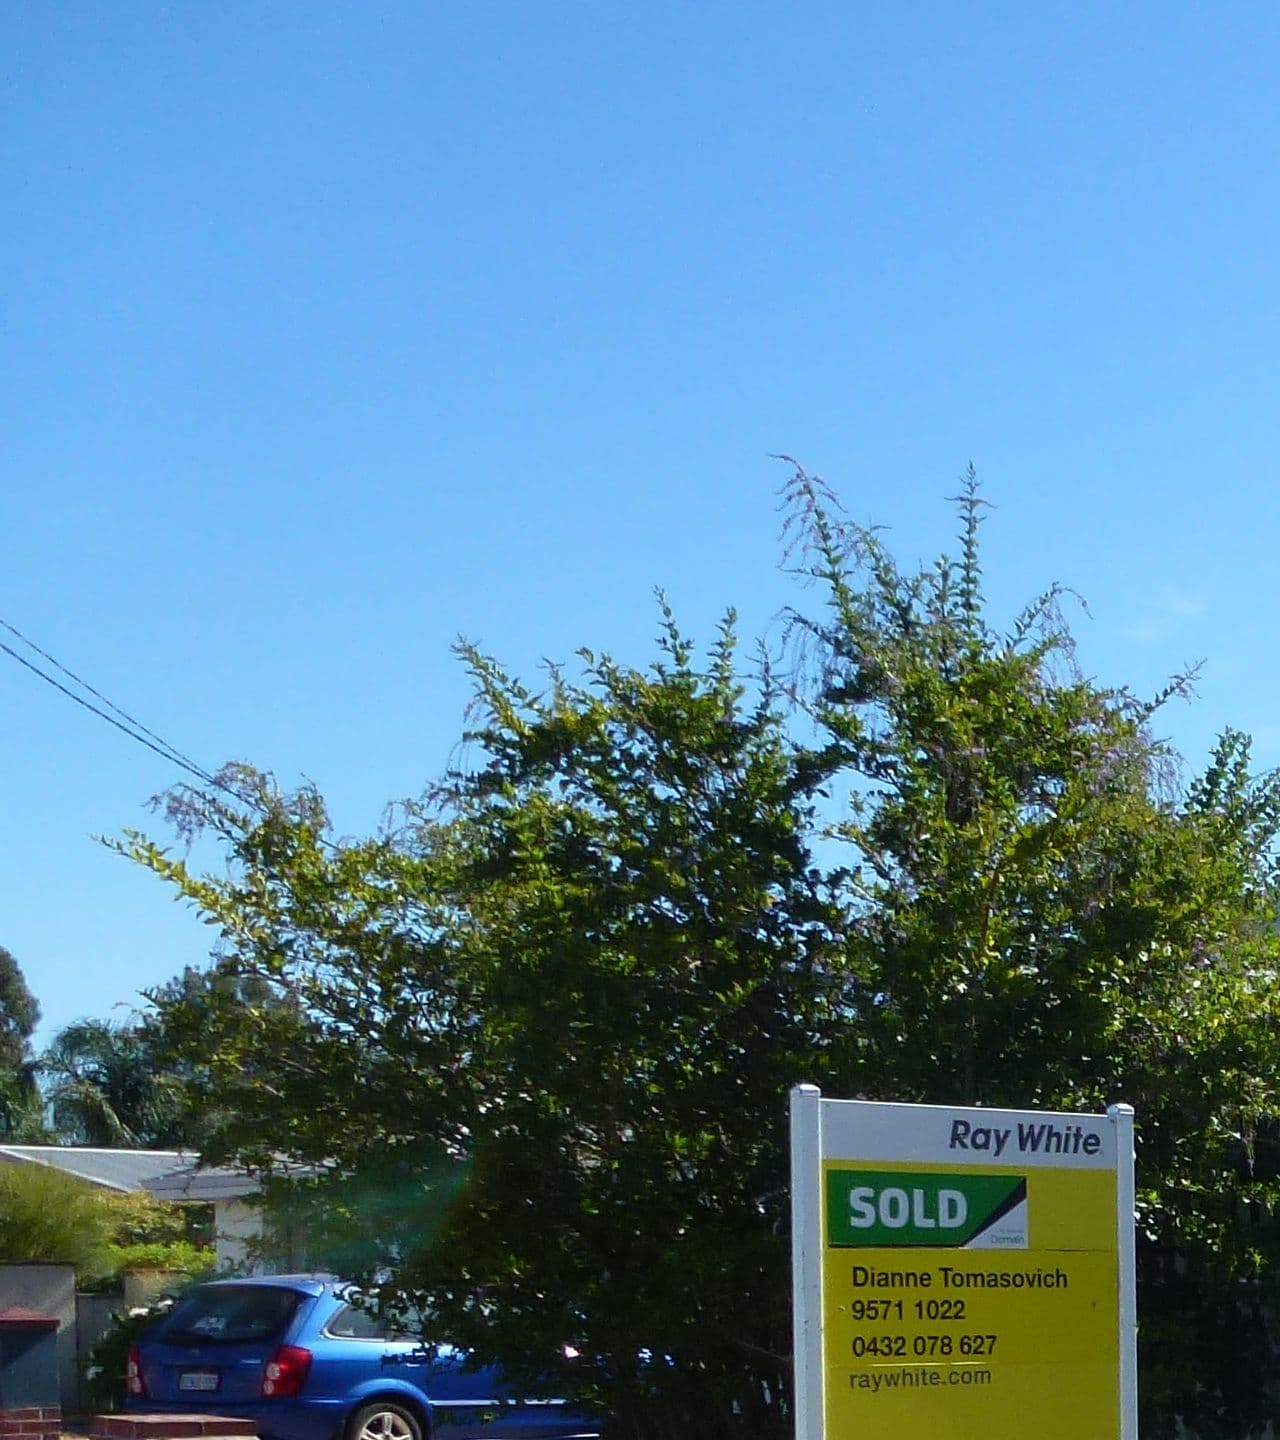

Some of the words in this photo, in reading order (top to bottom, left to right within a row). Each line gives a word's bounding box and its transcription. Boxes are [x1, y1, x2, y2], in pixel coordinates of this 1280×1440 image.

[949, 1119, 1011, 1157] Ray
[1017, 1122, 1101, 1155] White
[849, 1187, 968, 1229] SOLD
[852, 1266, 932, 1289] Dianne
[938, 1267, 1068, 1289] Tomasovich
[852, 1300, 904, 1321] 9571
[915, 1300, 966, 1320] 1022
[852, 1336, 906, 1357] 0432
[913, 1336, 953, 1356] 078
[959, 1335, 997, 1355] 627
[849, 1367, 992, 1393] raywhite.com
